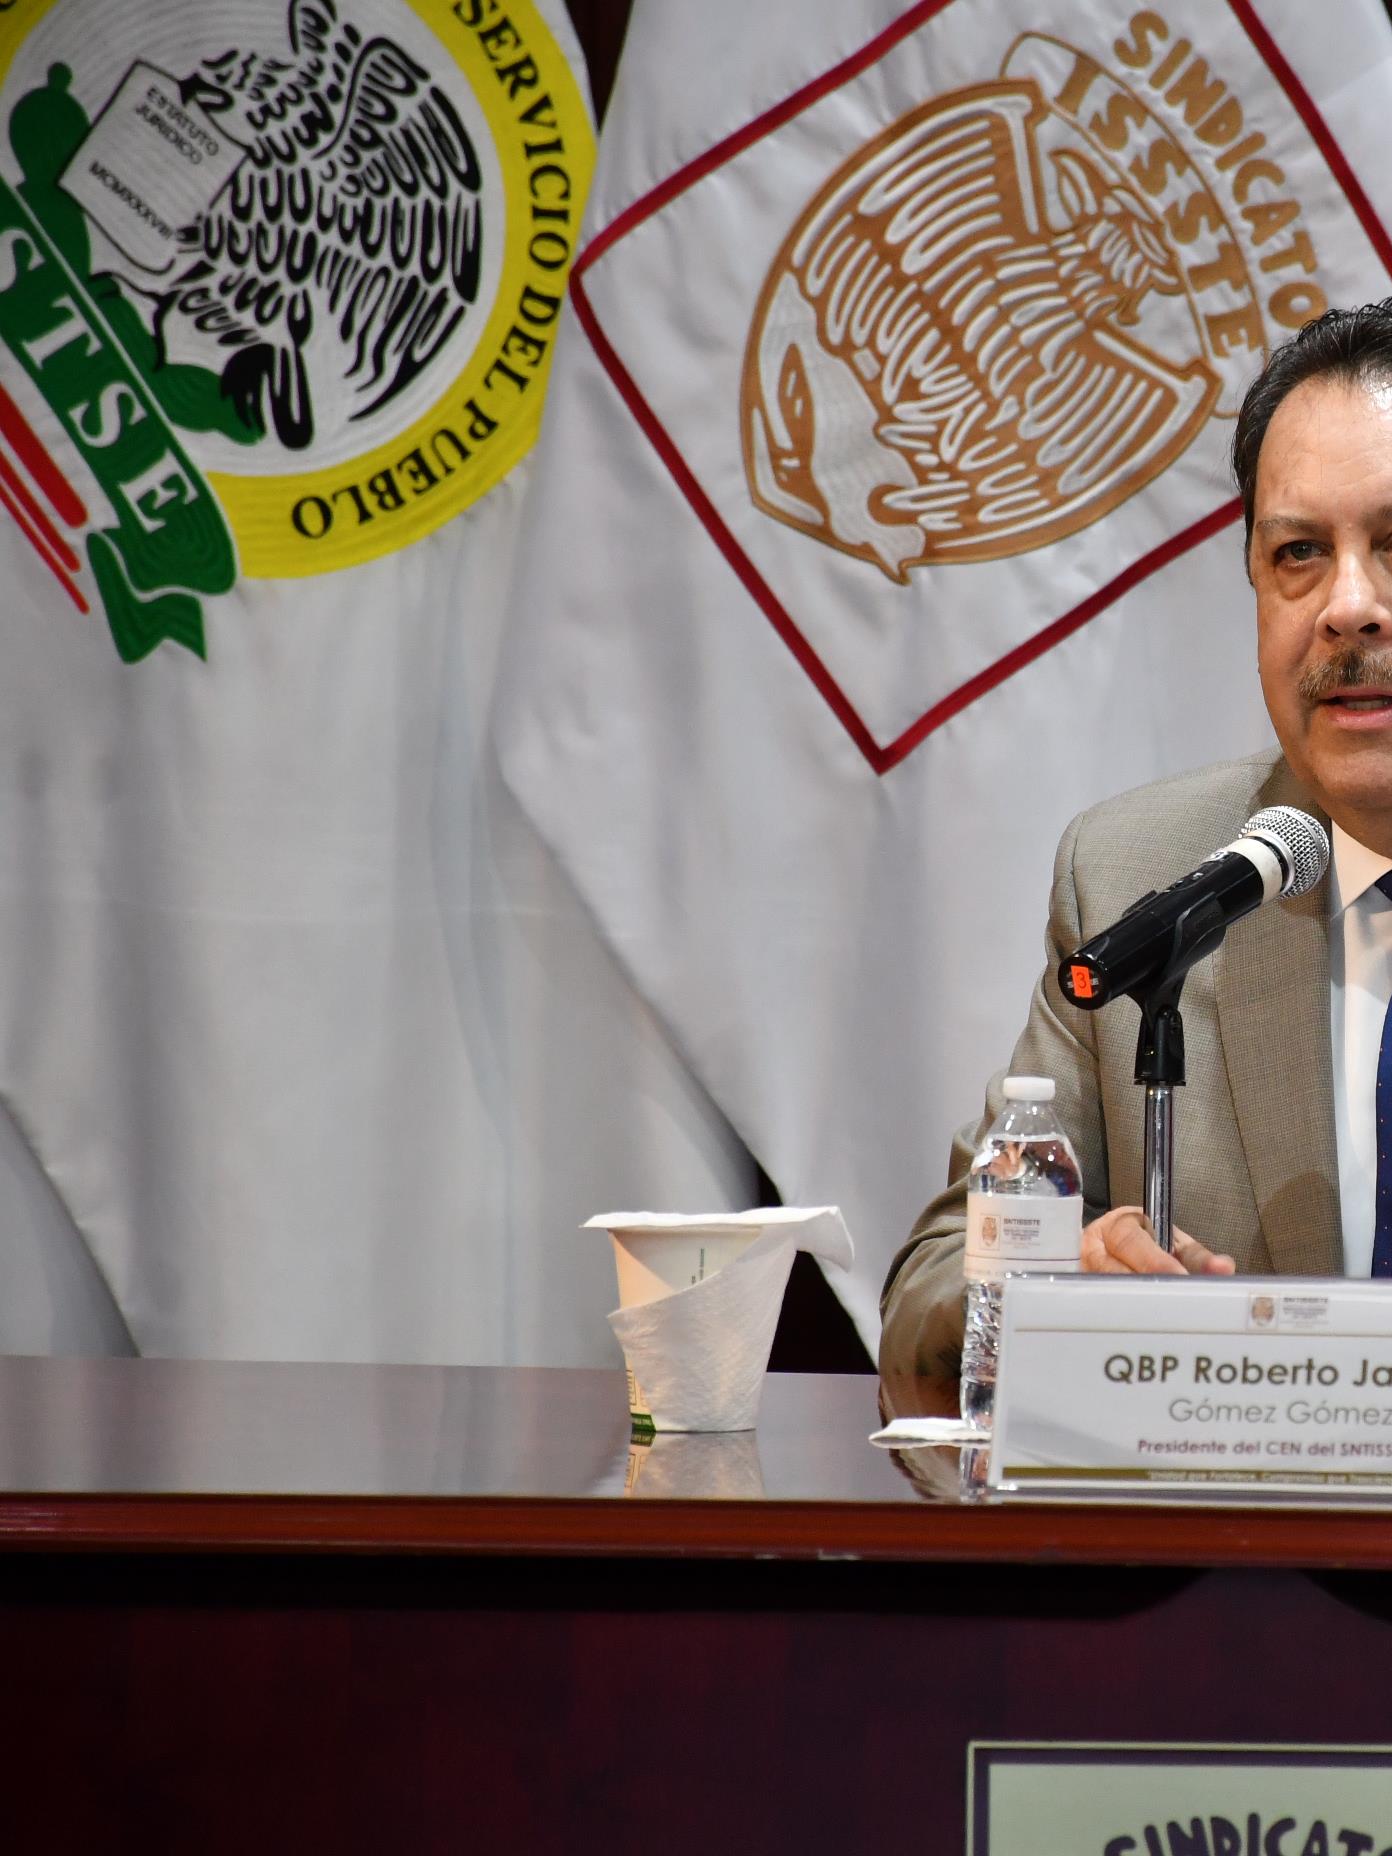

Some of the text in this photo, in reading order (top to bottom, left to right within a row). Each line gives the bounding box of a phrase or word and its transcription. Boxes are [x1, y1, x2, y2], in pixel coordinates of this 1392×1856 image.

[147, 85, 219, 156] ESTATUTO
[1112, 10, 1328, 329] SINDICATO
[1055, 53, 1262, 359] ISSSTE
[290, 0, 572, 540] SERVICIO DEL PUEBLO
[1077, 972, 1087, 988] 3
[1103, 1354, 1179, 1384] QBP
[1193, 1356, 1340, 1387] Roberto
[1168, 1398, 1277, 1424] Gómez
[1137, 1439, 1227, 1455] Presidente
[1233, 1441, 1261, 1456] del
[1266, 1442, 1302, 1456] CEN
[1307, 1443, 1335, 1457] del
